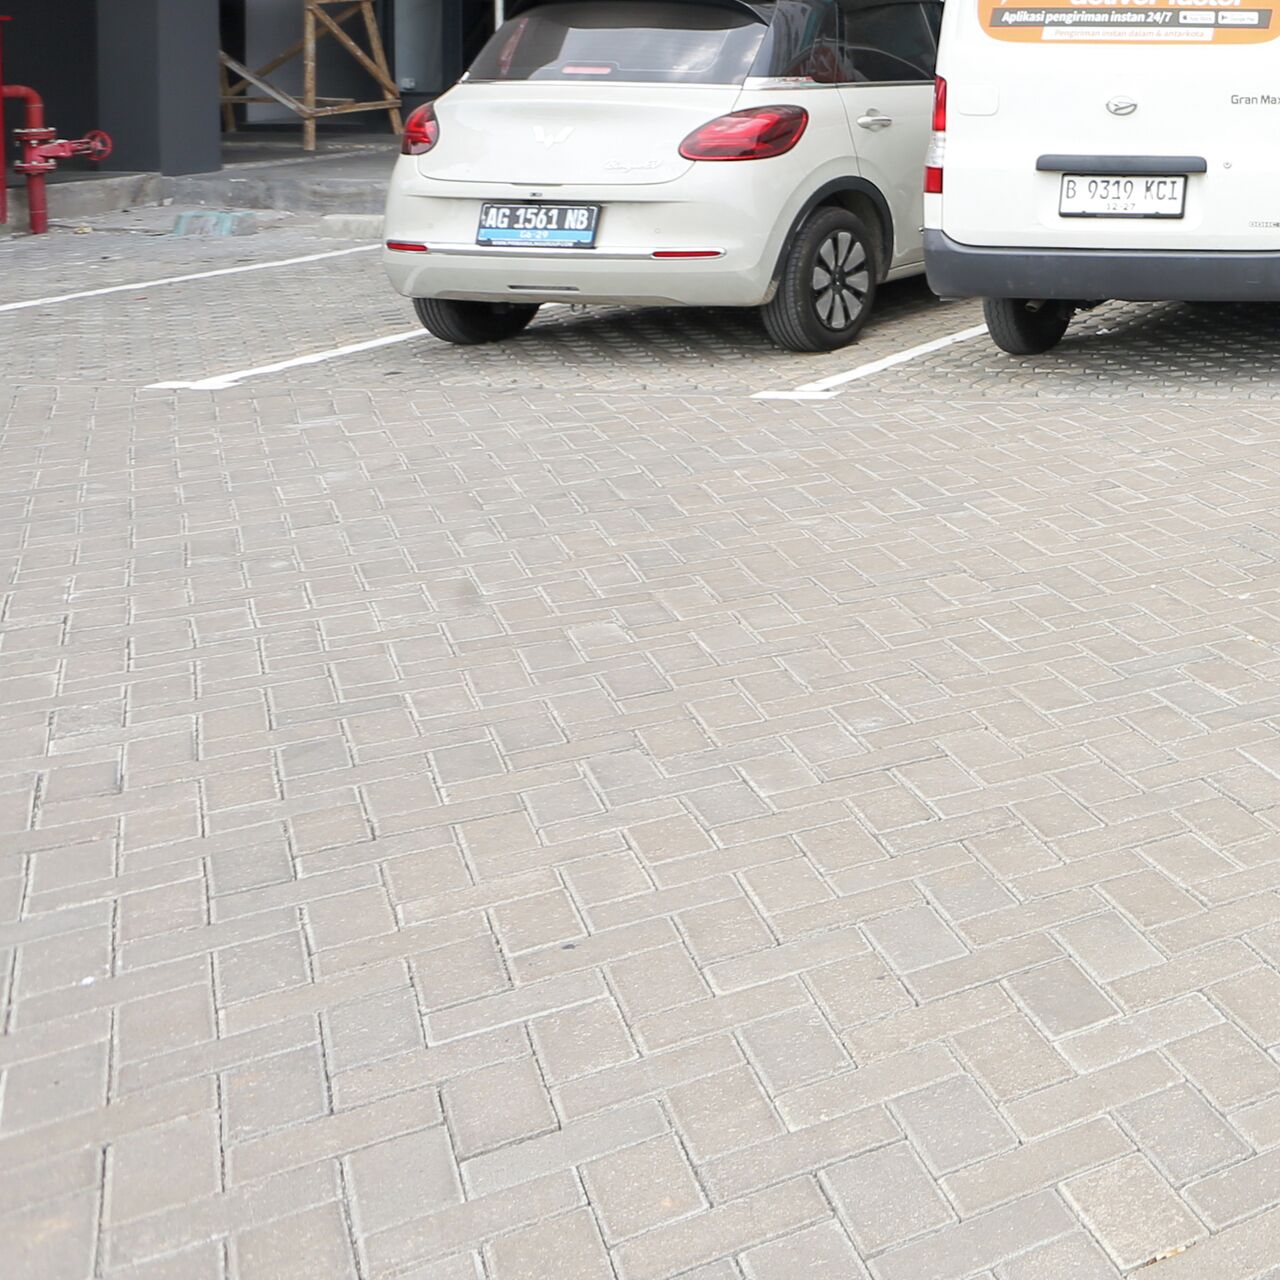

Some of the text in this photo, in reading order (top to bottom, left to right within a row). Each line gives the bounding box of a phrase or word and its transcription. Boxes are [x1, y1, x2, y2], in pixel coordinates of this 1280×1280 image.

[1001, 11, 1172, 24] Aplikasi pengiriman instan 24/7
[1230, 94, 1258, 104] Gran
[1066, 179, 1178, 200] B 9319 KCI
[485, 207, 588, 229] AG 1561 NB
